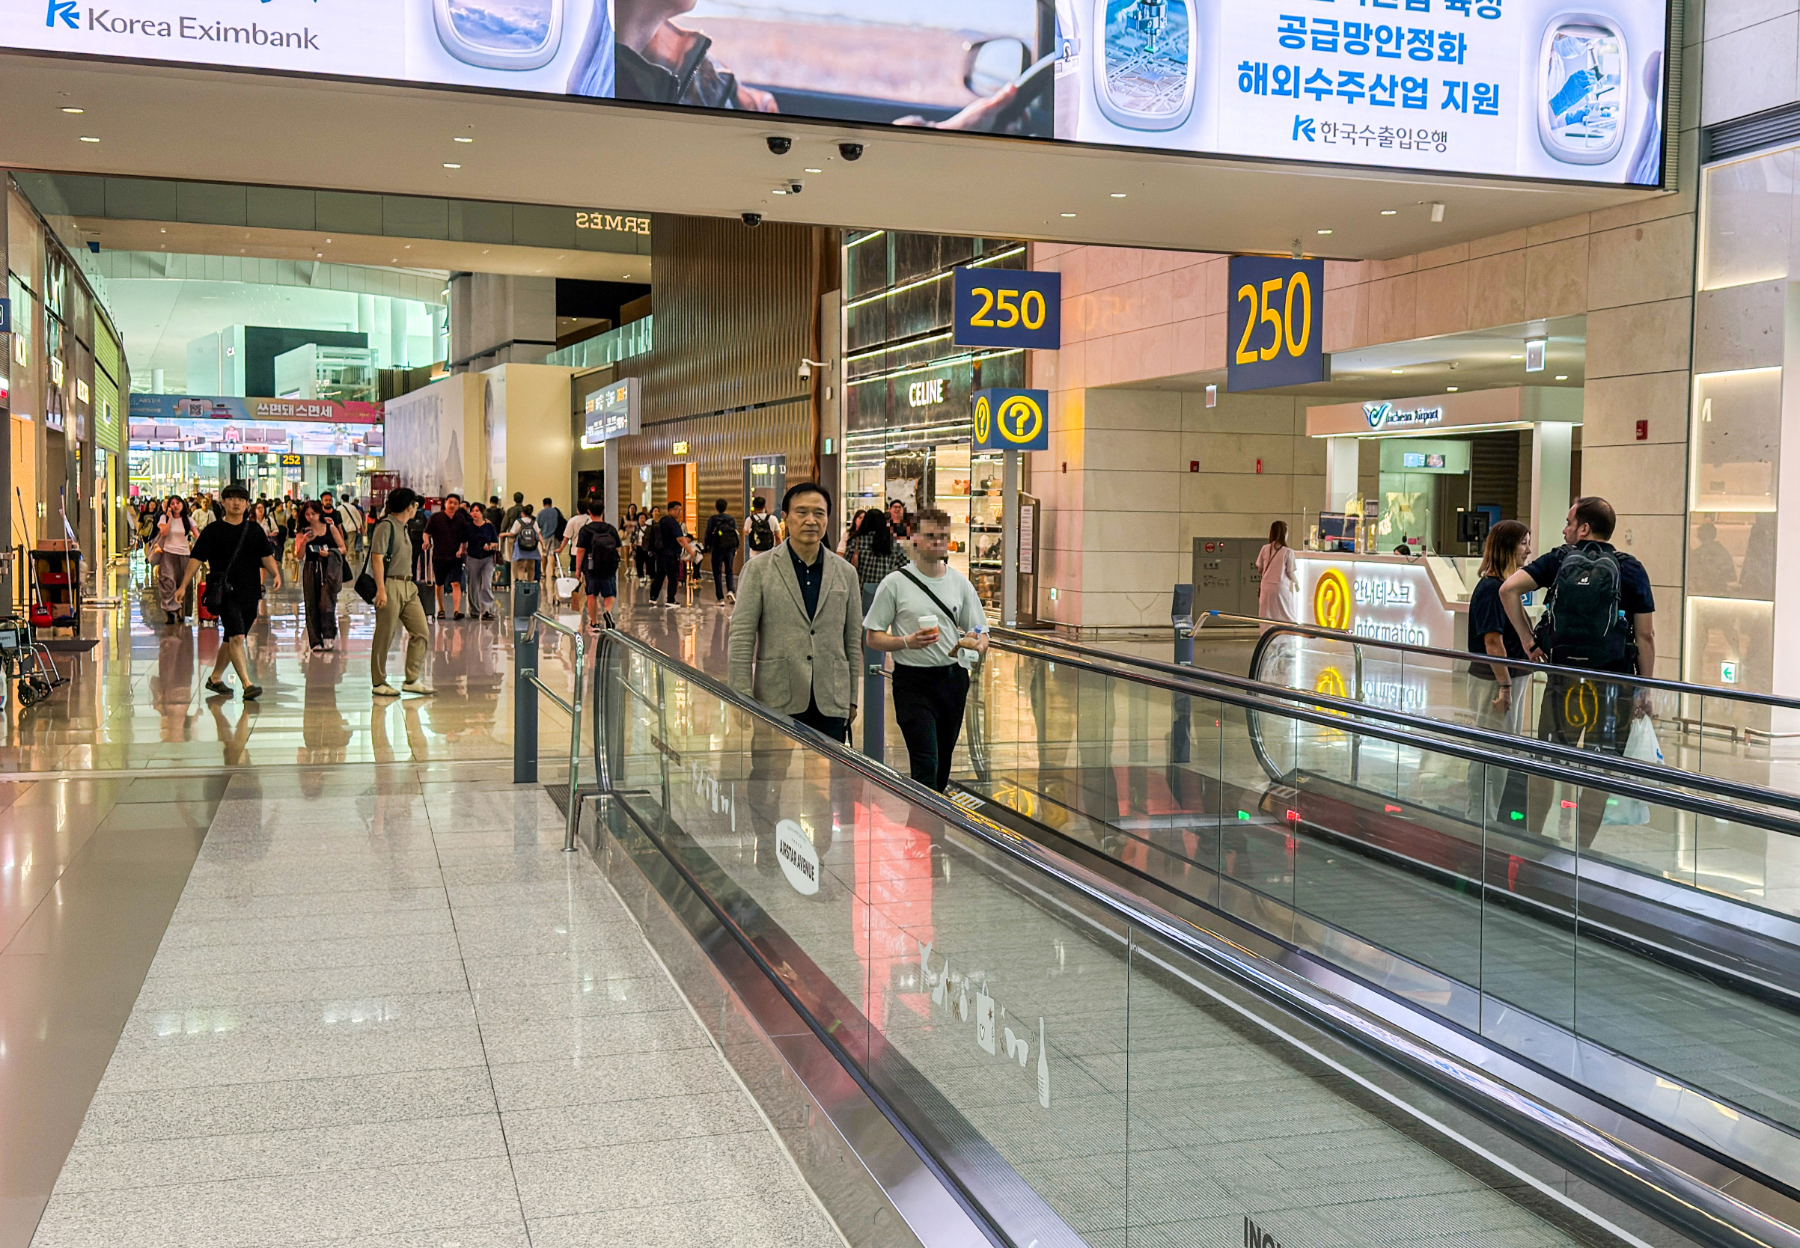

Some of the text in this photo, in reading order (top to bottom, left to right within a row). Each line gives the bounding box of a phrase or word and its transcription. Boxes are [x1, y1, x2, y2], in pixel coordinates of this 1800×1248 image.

[88, 8, 320, 50] Korea Eximbank
[1277, 14, 1467, 65] 공급망안정화
[1237, 60, 1500, 116] 해외수주산업 지원
[1320, 120, 1448, 153] 한국수출입은행
[969, 287, 1046, 330] 250
[1235, 271, 1312, 365] 250
[908, 378, 944, 408] CELINE
[295, 404, 333, 418] 스면세
[1414, 408, 1440, 423] Airport
[282, 454, 301, 466] 252
[1354, 579, 1413, 605] 안내데스크
[1354, 618, 1426, 646] Information
[796, 853, 815, 882] AVENUE
